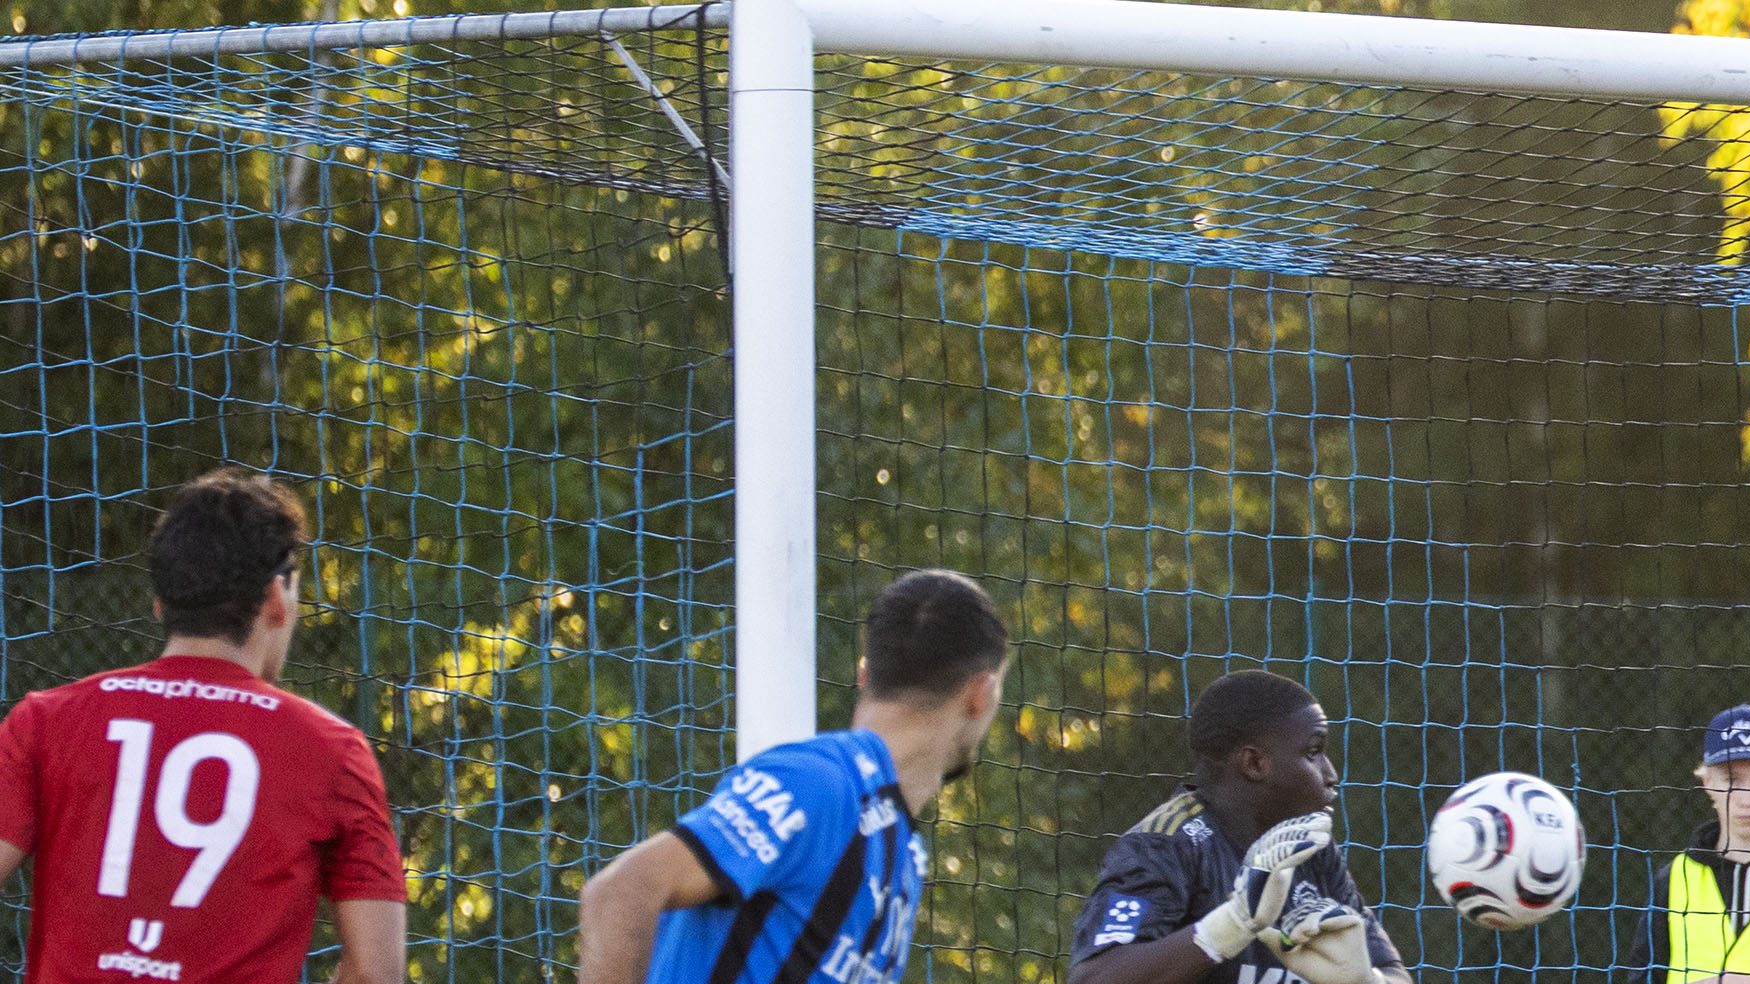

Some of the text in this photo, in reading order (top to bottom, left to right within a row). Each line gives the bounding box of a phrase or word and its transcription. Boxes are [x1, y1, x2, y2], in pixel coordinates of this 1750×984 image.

[99, 676, 281, 711] octapharma
[97, 717, 261, 909] 19
[98, 952, 182, 982] unisport
